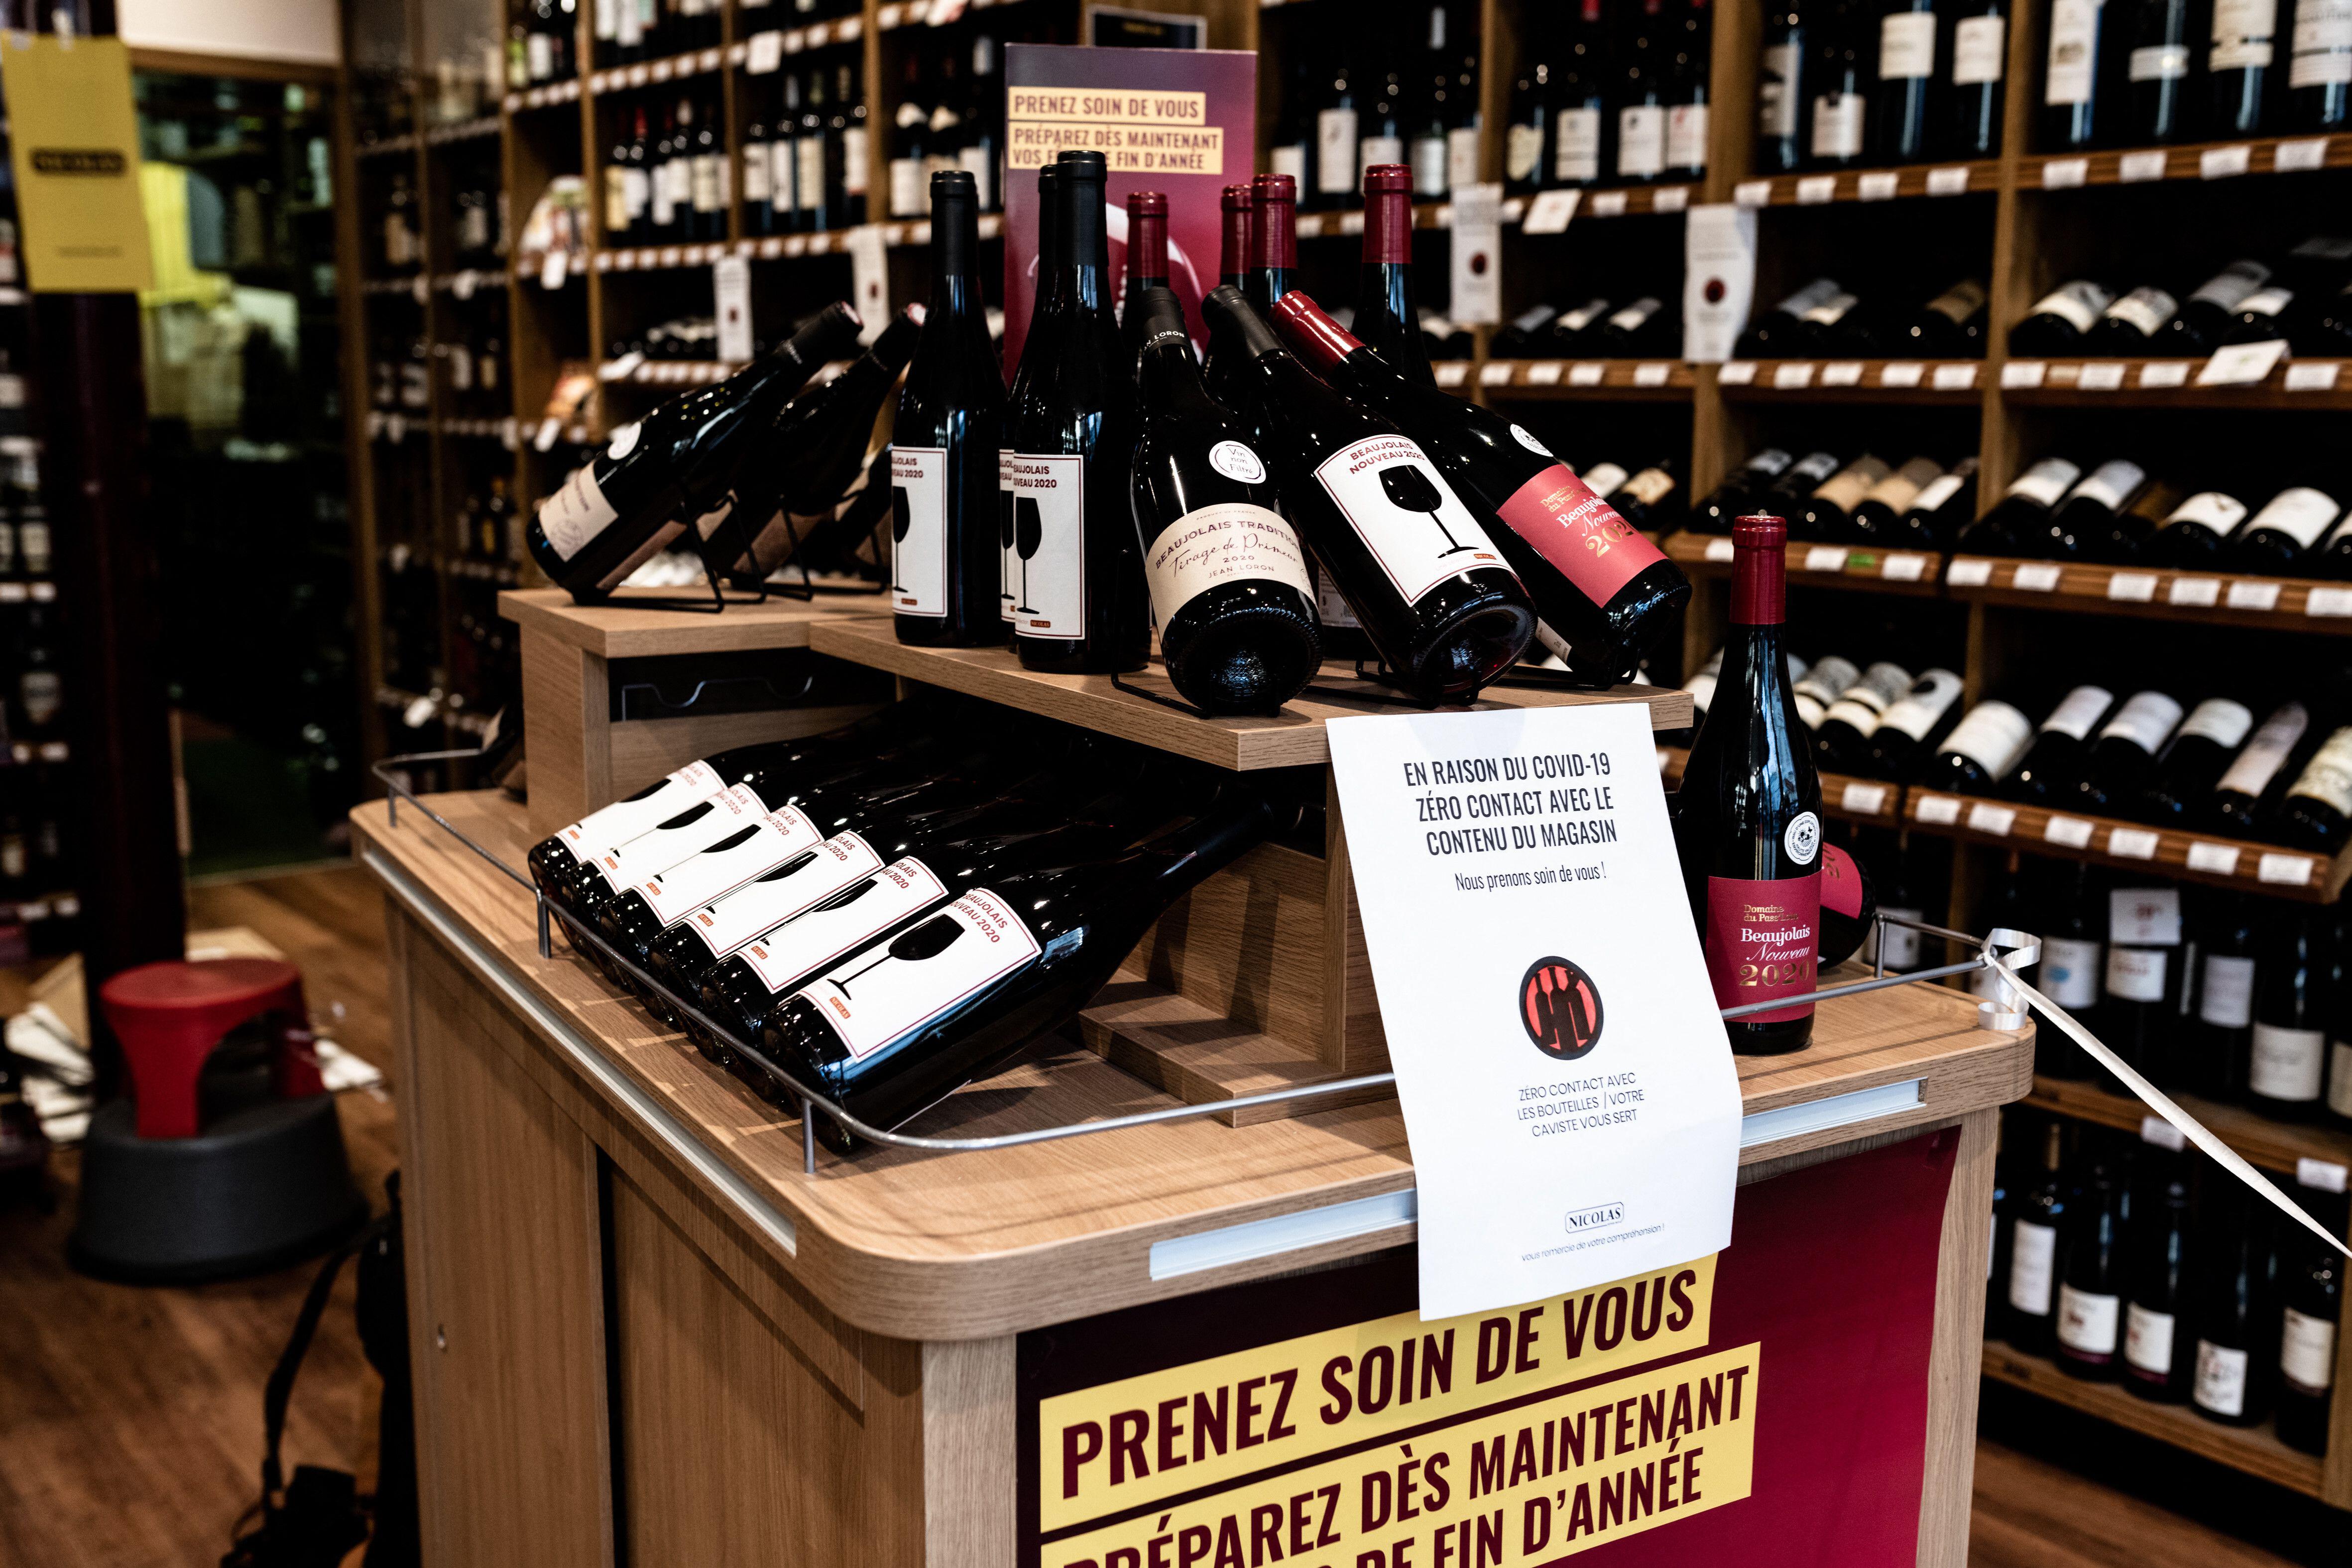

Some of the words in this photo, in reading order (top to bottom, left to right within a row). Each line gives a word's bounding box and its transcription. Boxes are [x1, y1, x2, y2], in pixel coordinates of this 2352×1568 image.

[1014, 95, 1076, 114] PRENEZ
[1083, 97, 1122, 116] SOIN
[1129, 99, 1148, 117] DE
[1155, 100, 1199, 118] VOUS
[1014, 123, 1089, 146] PRÉPAREZ
[1095, 126, 1122, 147] DÈS
[1127, 131, 1218, 149] MAINTENANT
[1013, 149, 1042, 165] VOS
[1117, 151, 1139, 167] FIN
[1155, 331, 1184, 340] LORON
[1228, 448, 1245, 457] Vin
[1349, 451, 1403, 474] NOUVEAU
[1350, 442, 1412, 460] BEAUJOLAIS
[1035, 479, 1057, 488] 2020
[1156, 521, 1231, 569] BEAUJOLAIS
[1168, 547, 1219, 577] Tirage
[1223, 537, 1238, 555] de
[1243, 533, 1297, 562] Primeur
[1209, 566, 1233, 578] JEAN
[1404, 762, 1428, 786] EN
[1432, 758, 1499, 785] RAISON
[1502, 756, 1528, 781] DU
[1532, 752, 1611, 779] COVID-19
[725, 800, 741, 815] 2020
[1415, 790, 1461, 822] ZÉRO
[1467, 791, 1542, 819] CONTACT
[1549, 788, 1591, 813] AVEC
[1594, 786, 1614, 810] LE
[772, 820, 790, 835] 2020
[1426, 827, 1508, 855] CONTENU
[1512, 825, 1536, 849] DU
[1540, 819, 1618, 847] MAGASIN
[829, 845, 848, 861] 2020
[889, 872, 909, 889] 2020
[1455, 872, 1485, 891] Nous
[1487, 871, 1531, 892] prenons
[1534, 867, 1557, 884] soin
[1559, 864, 1573, 882] de
[1575, 865, 1601, 881] vous
[1744, 905, 1784, 913] Domaine
[1744, 913, 1758, 922] du
[976, 919, 1000, 943] 2020
[1741, 924, 1810, 946] Beaujolais
[1746, 942, 1810, 961] Nouveau
[1739, 960, 1810, 986] 2020
[1519, 1085, 1546, 1101] ZÉRO
[1549, 1078, 1603, 1095] CONTACT
[1608, 1073, 1636, 1087] AVEC
[1518, 1107, 1535, 1120] LES
[1537, 1097, 1599, 1117] BOUTEILLES
[1609, 1089, 1645, 1105] VOTRE
[1532, 1119, 1578, 1137] CAVISTE
[1580, 1114, 1611, 1129] VOUS
[1613, 1109, 1637, 1123] SERT
[1568, 1207, 1621, 1229] NICOLAS
[1522, 1252, 1540, 1261] vous
[1576, 1241, 1586, 1250] de
[1587, 1237, 1606, 1248] votre
[1062, 1368, 1298, 1500] PRENEZ
[1320, 1328, 1454, 1426] SOIN
[1476, 1306, 1544, 1384] DE
[1563, 1269, 1696, 1360] VOUS
[1362, 1444, 1449, 1534] DÈS
[1470, 1365, 1749, 1500] MAINTENANT
[1434, 1509, 1503, 1568] FIN
[1523, 1437, 1704, 1556] D'ANNÉE
